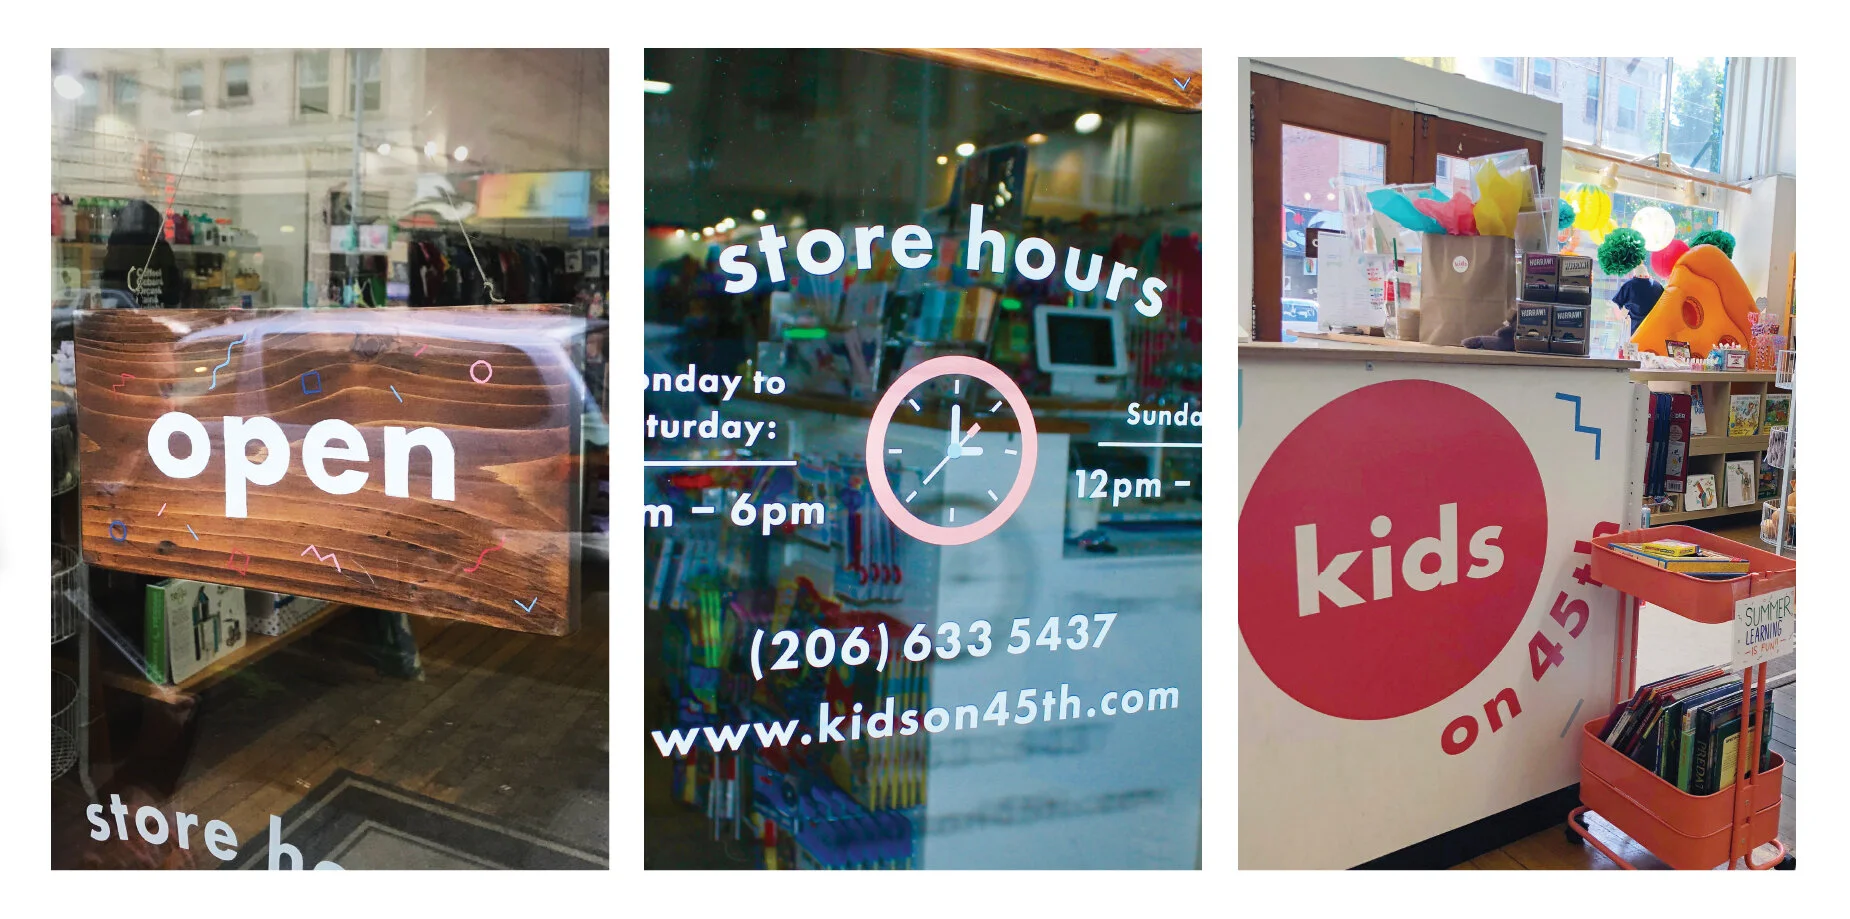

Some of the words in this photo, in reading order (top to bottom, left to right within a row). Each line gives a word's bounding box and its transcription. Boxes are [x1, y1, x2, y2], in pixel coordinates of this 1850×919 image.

[719, 224, 933, 294] store
[966, 203, 1168, 317] hours
[644, 363, 742, 401] nday
[753, 370, 786, 395] to
[646, 410, 777, 447] turday:
[1127, 402, 1203, 426] Sunda
[147, 411, 456, 519] open
[1075, 468, 1162, 507] 12pm
[730, 492, 826, 536] 6pm
[1294, 502, 1505, 618] kids
[1745, 596, 1791, 627] SUMMER
[1745, 620, 1783, 645] LEARNING
[751, 622, 889, 681] (206)
[903, 620, 992, 662] 633
[1007, 613, 1118, 655] 5437
[1751, 646, 1758, 656] IS
[651, 683, 1180, 758] www.kidson45th.com
[1440, 687, 1522, 756] on
[86, 793, 238, 861] store
[268, 814, 346, 871] h
